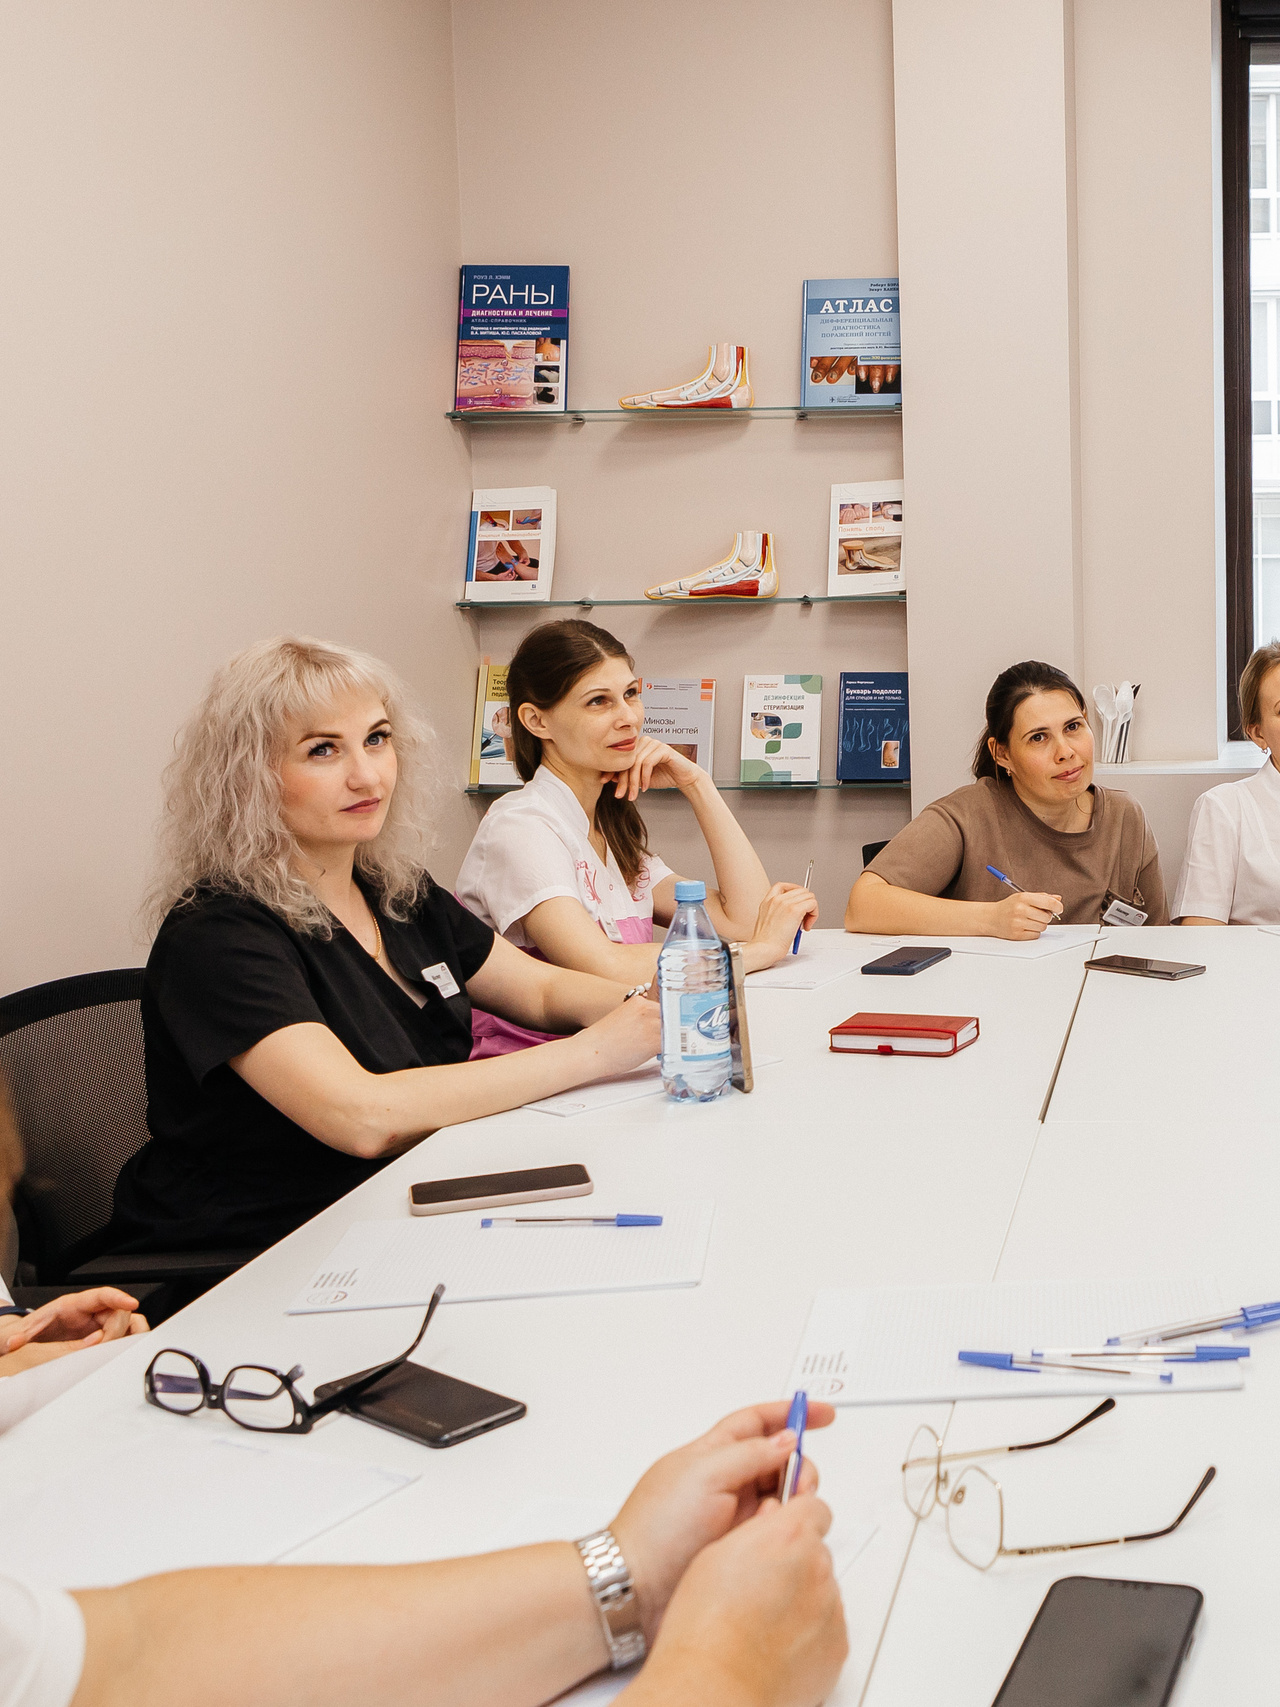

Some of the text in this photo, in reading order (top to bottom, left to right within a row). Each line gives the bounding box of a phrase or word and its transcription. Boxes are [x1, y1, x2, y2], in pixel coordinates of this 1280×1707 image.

[472, 284, 554, 305] РАНЫ
[820, 299, 893, 313] АТЛАС
[643, 717, 675, 725] Микозы
[671, 726, 699, 735] ногтей
